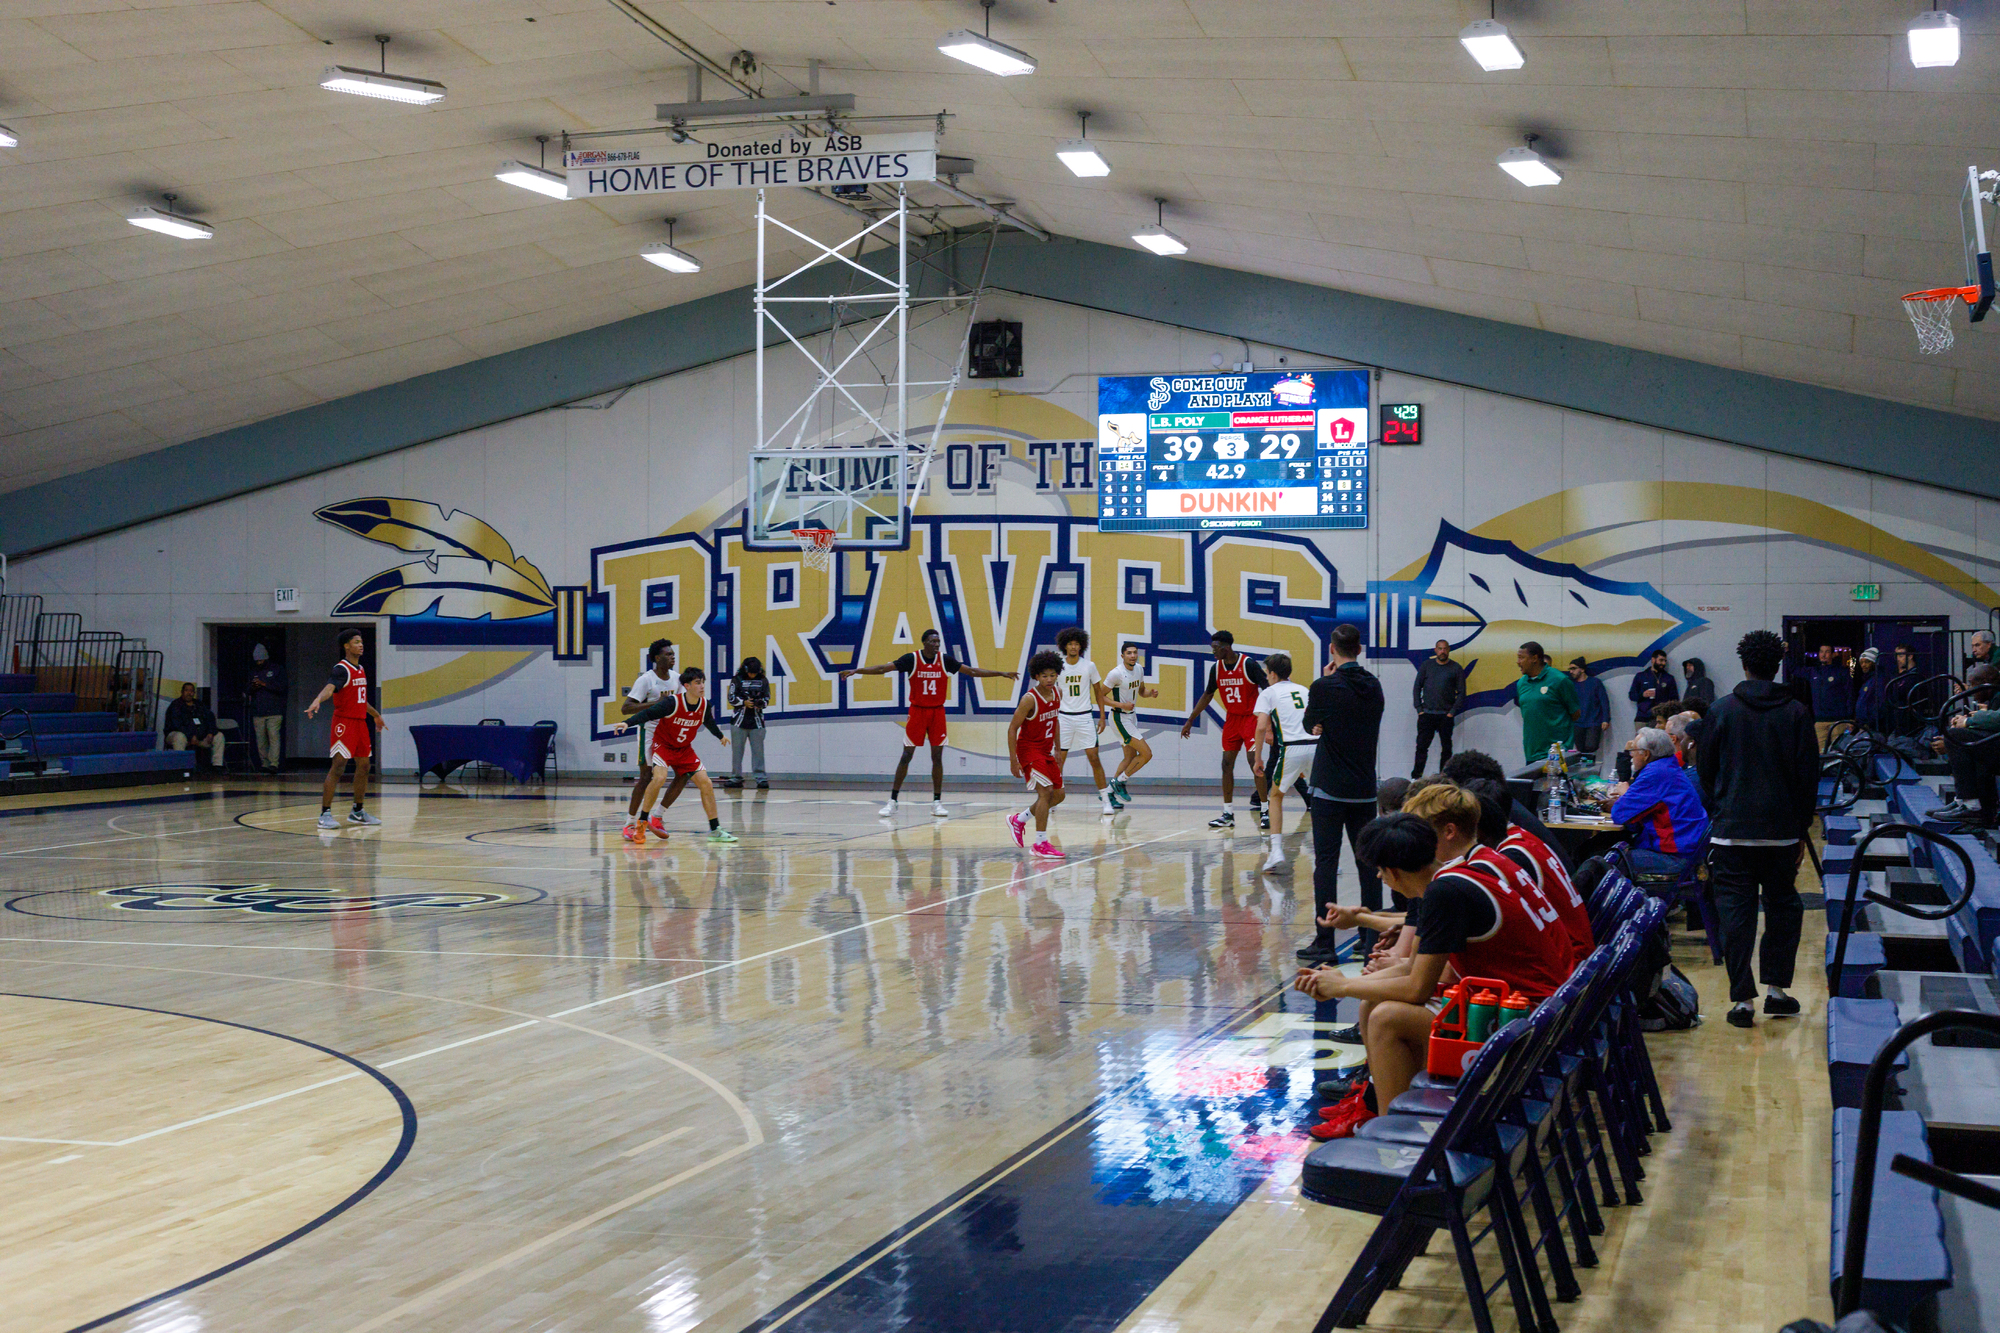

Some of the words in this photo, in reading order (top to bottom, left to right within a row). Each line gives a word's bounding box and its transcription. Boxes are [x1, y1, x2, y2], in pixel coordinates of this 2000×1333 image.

[707, 139, 782, 158] Donated
[790, 138, 812, 156] by
[825, 135, 862, 152] ASB
[607, 151, 640, 161] 866-678-FLAG
[588, 166, 676, 193] HOME
[685, 163, 724, 188] OF
[730, 160, 788, 186] THE
[798, 153, 909, 183] BRAVES
[1173, 379, 1213, 391] COME
[1216, 377, 1246, 391] OUT
[1189, 394, 1220, 407] AND
[1224, 393, 1271, 406] PLAY!
[1151, 417, 1172, 428] L.B.
[1174, 416, 1205, 427] POLY
[1233, 415, 1269, 424] ORANGE
[1270, 415, 1313, 423] LUTHERAN
[1384, 421, 1418, 443] 24
[1164, 436, 1203, 461] 39
[1227, 443, 1236, 456] 3
[1260, 433, 1301, 460] 29
[786, 444, 926, 492] HOME
[947, 444, 1006, 490] OF
[1029, 441, 1096, 490] TH
[1106, 462, 1112, 470] 1
[1324, 457, 1331, 466] 2
[1158, 470, 1168, 481] 4
[1205, 463, 1246, 479] 42.9
[1295, 468, 1305, 479] 3
[1323, 469, 1331, 478] 5
[1341, 469, 1347, 477] 3
[1105, 473, 1113, 482] 3
[1105, 484, 1113, 493] 4
[1105, 496, 1113, 505] 5
[1135, 496, 1142, 504] 0
[1180, 491, 1283, 513] DUNKIN'
[1322, 493, 1333, 501] 14
[1321, 505, 1334, 513] 24
[277, 589, 294, 601] EXIT
[1856, 585, 1876, 599] EXIT
[591, 514, 1337, 741] BRAVES
[1065, 675, 1082, 683] POLY
[1128, 679, 1139, 689] POLY
[1220, 678, 1243, 686] LUTHERAN
[922, 680, 937, 695] 14
[1069, 685, 1080, 696] 10
[357, 687, 367, 703] 13
[1225, 687, 1242, 703] 24
[1290, 691, 1305, 709] 5
[673, 717, 700, 727] LUTHERAN
[1045, 720, 1054, 738] 2
[677, 728, 689, 743] 5
